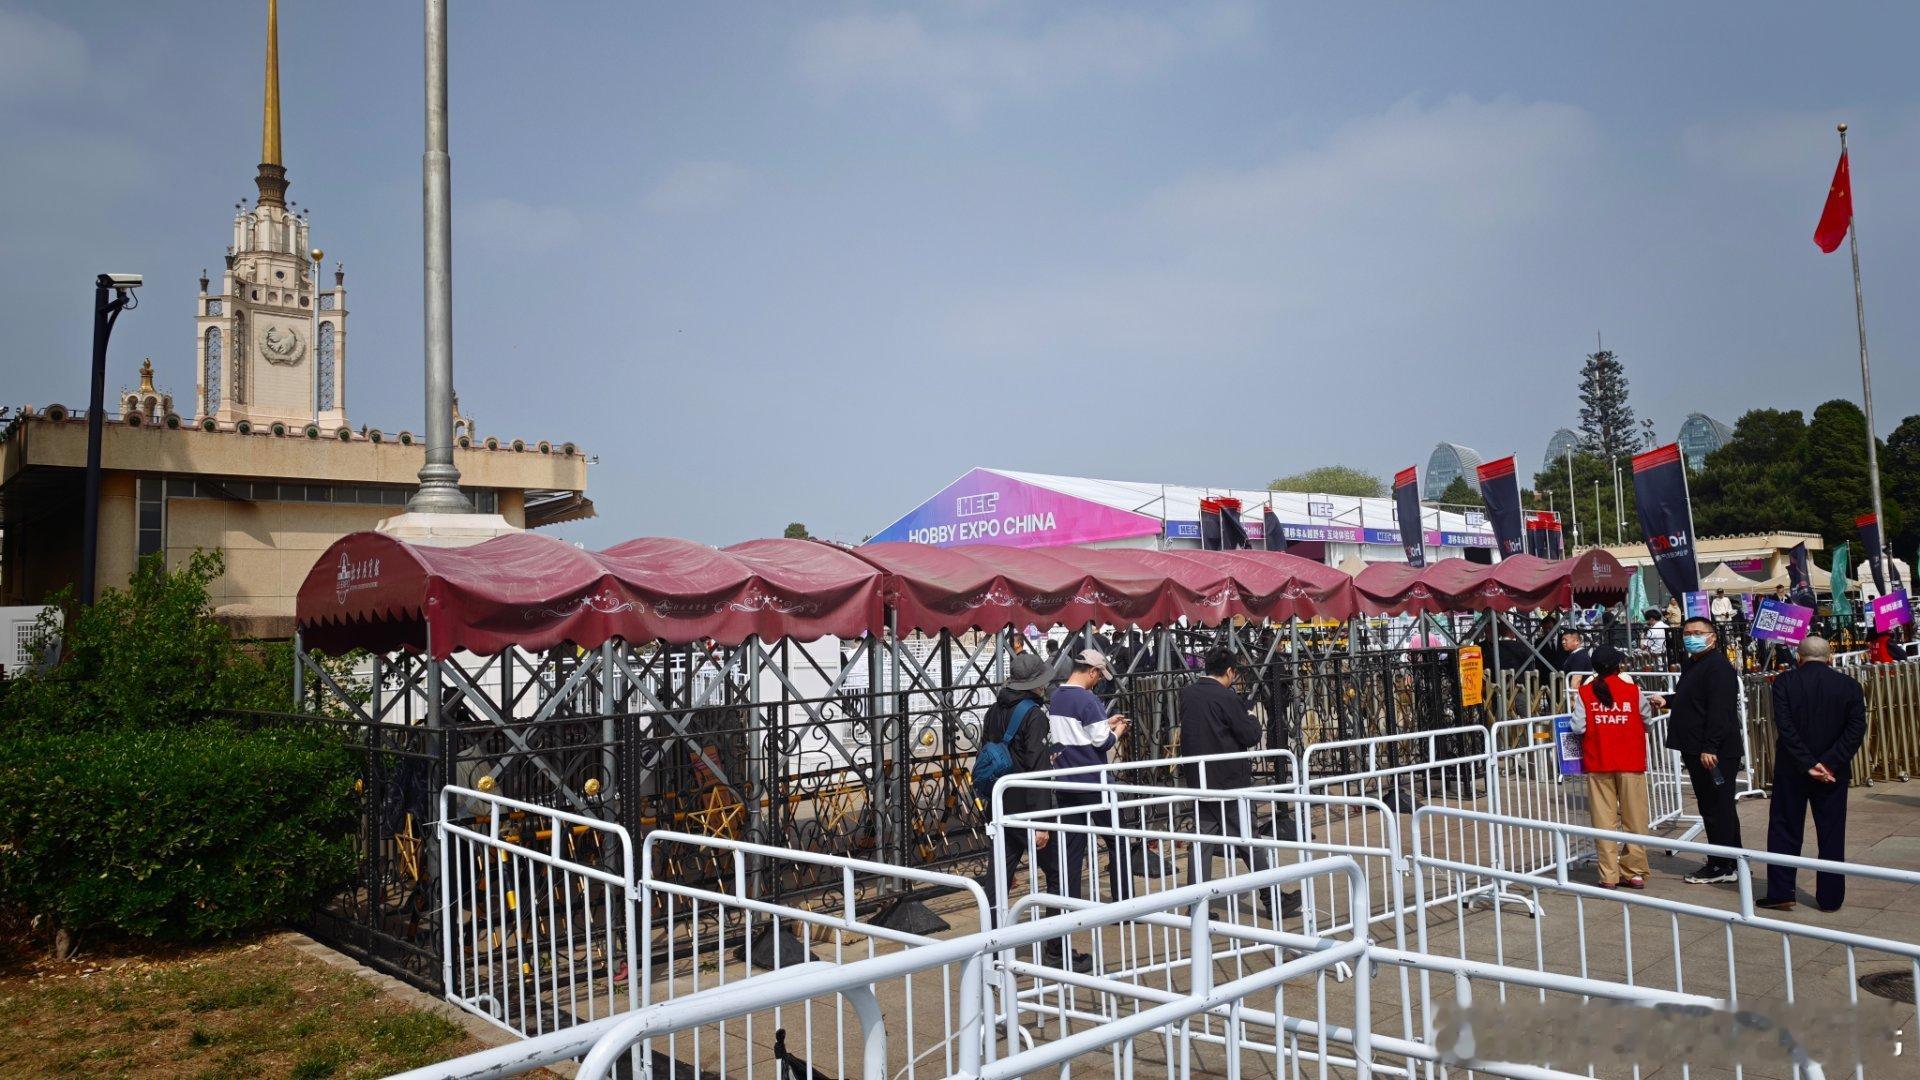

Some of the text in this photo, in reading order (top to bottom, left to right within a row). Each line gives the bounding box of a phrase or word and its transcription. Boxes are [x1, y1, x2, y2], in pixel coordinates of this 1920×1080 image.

[908, 511, 1057, 545] HOBBY EXPO CHINA
[1594, 714, 1629, 725] STAFF
